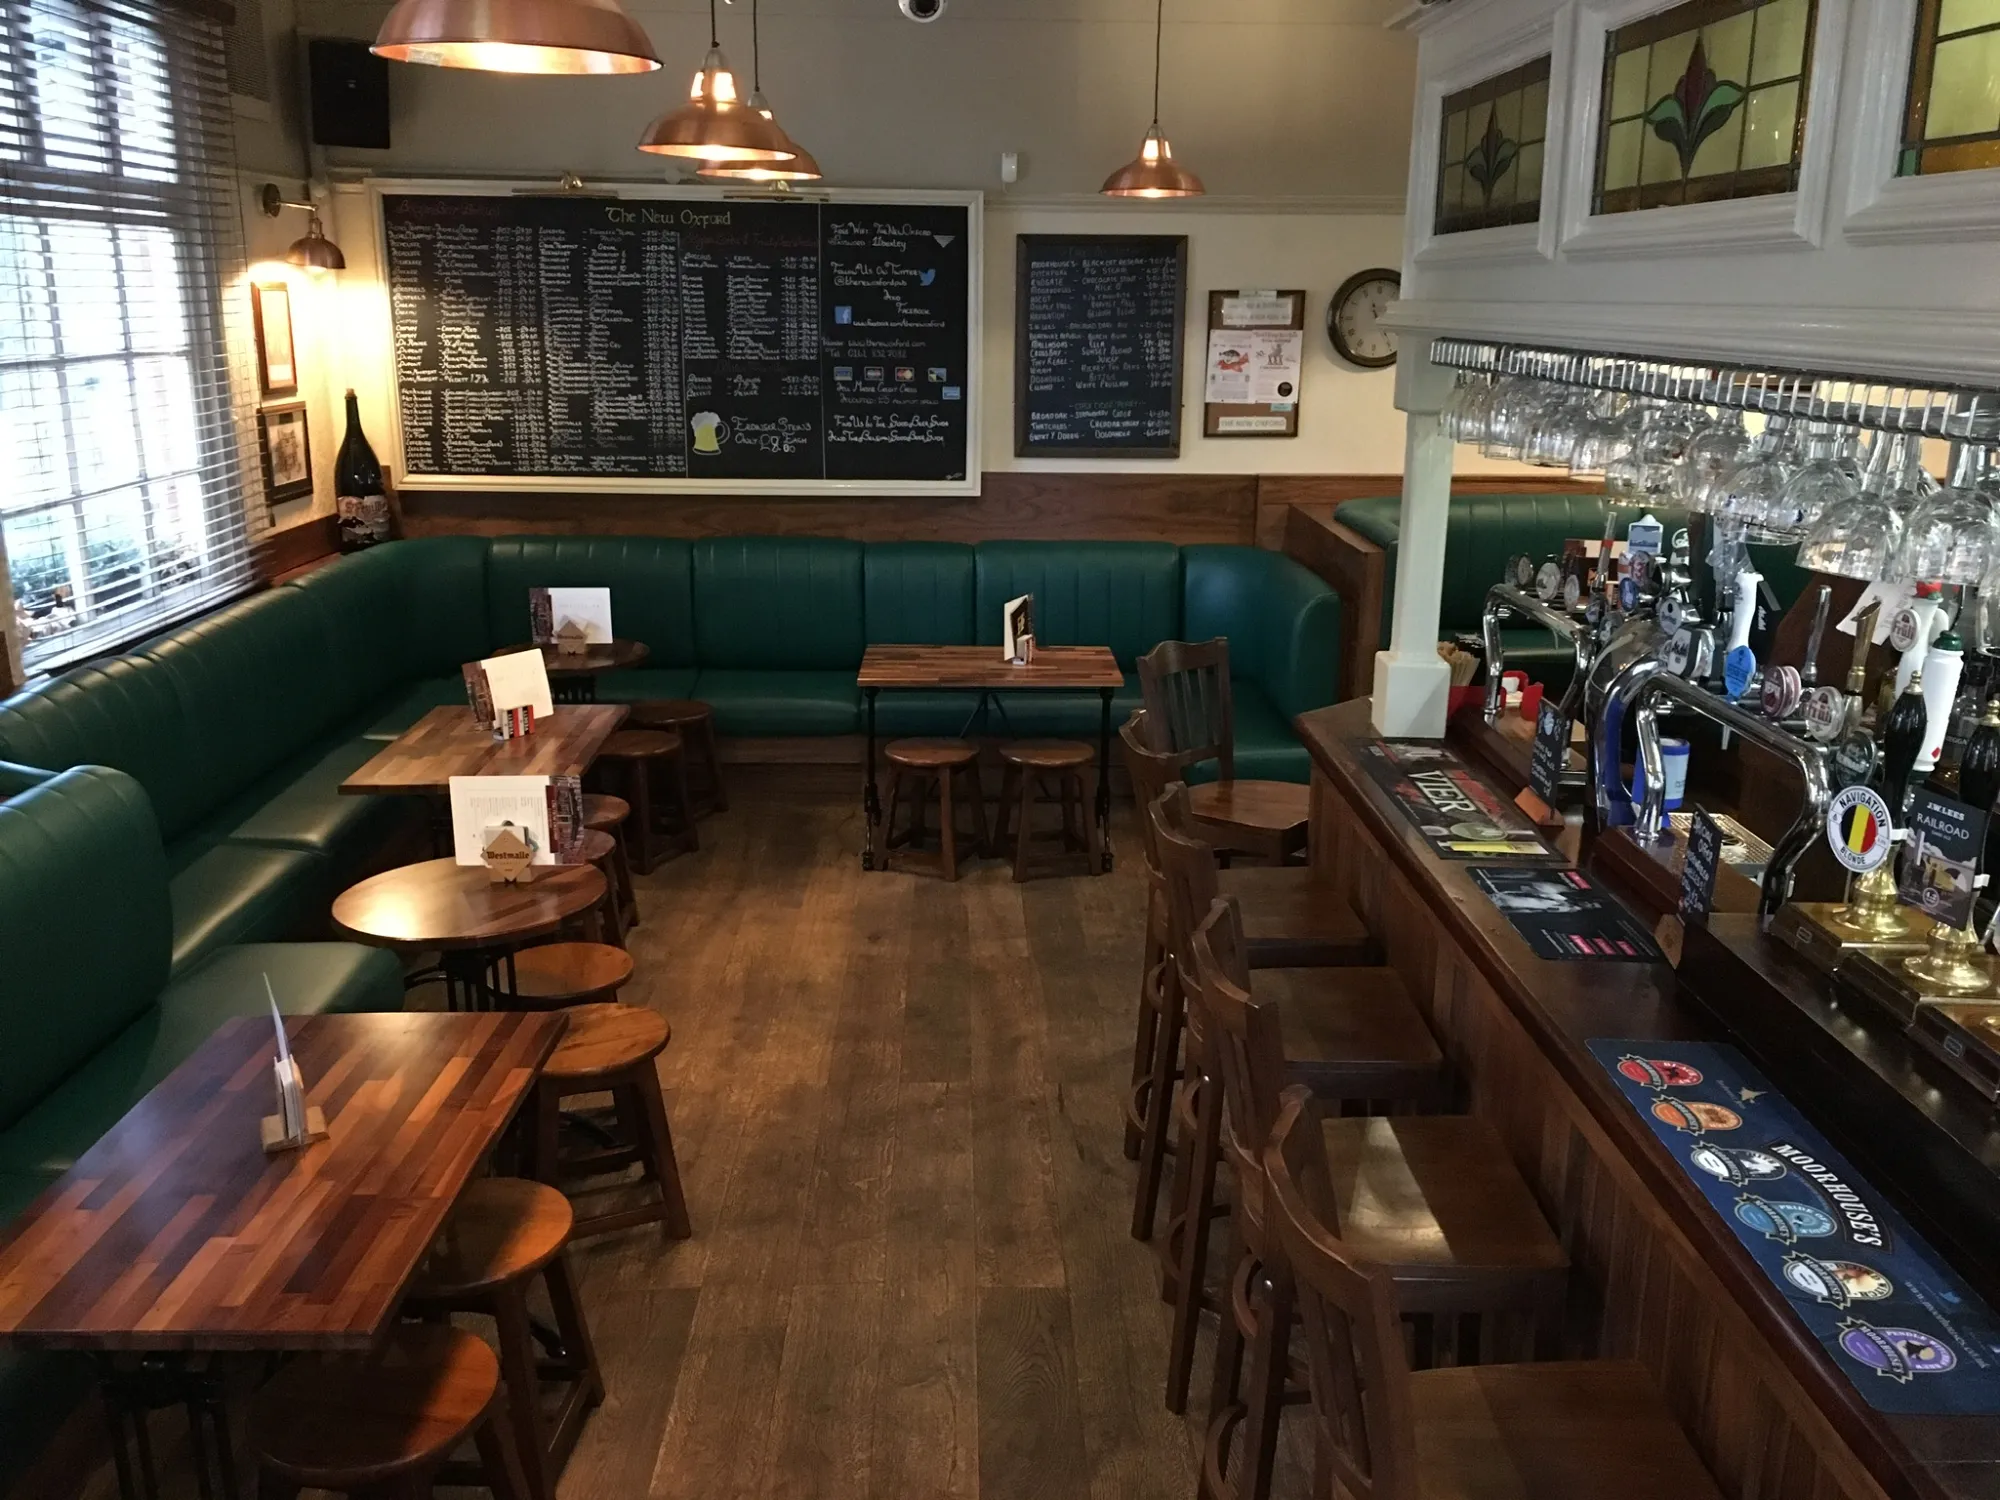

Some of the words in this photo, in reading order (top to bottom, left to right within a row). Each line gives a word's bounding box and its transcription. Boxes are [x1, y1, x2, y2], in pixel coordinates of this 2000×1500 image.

[605, 206, 637, 223] The
[641, 209, 675, 224] New
[1406, 768, 1478, 814] VIER
[1838, 791, 1887, 828] NAVIGATION
[1916, 812, 1970, 841] RAILROAD
[486, 850, 530, 861] Westmalle
[1839, 845, 1866, 865] BLONDE
[1769, 1142, 1886, 1250] MOORHOUSE'S
